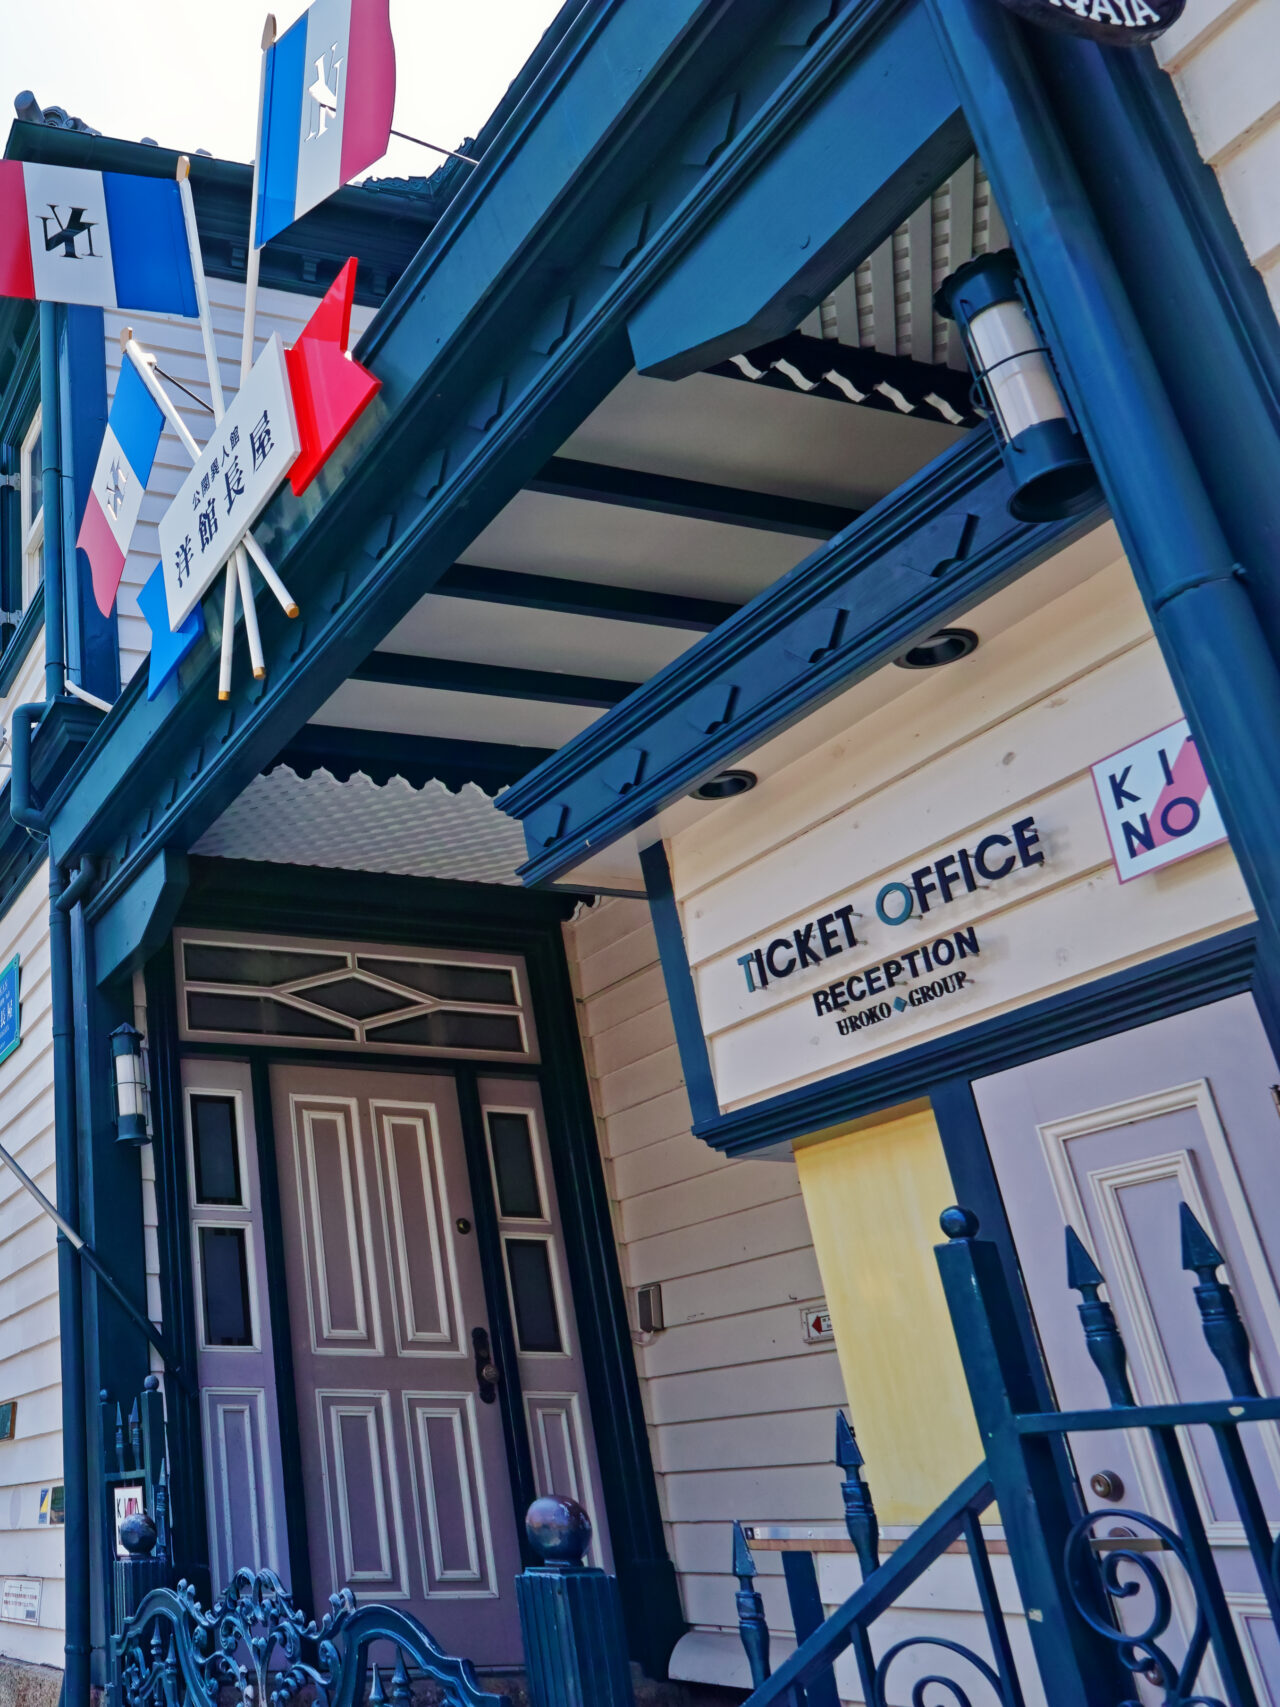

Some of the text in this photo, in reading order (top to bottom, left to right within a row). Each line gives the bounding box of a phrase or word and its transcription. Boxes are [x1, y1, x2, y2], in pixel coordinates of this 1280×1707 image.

[1049, 0, 1161, 27] GAYA
[175, 409, 275, 588] 洋館長屋
[1108, 735, 1194, 811] KI
[737, 816, 1045, 993] TICKET OFFICE
[812, 926, 980, 1017] RECEPTION
[836, 970, 967, 1036] UROKO GROUP
